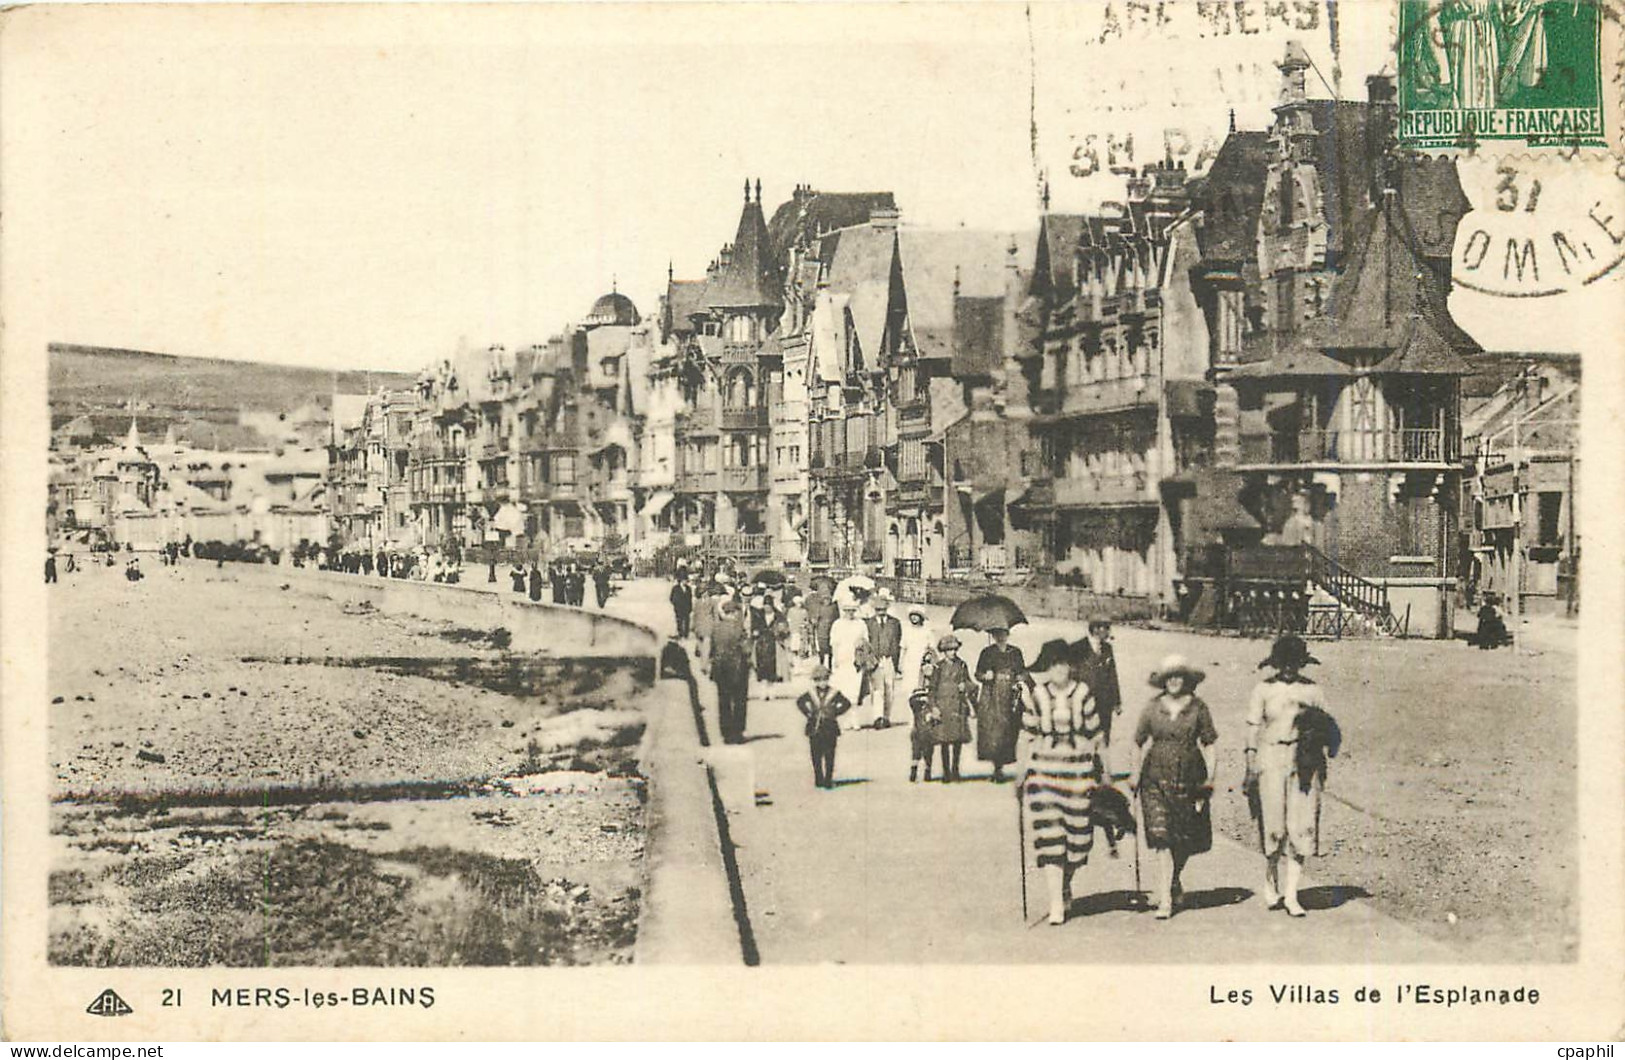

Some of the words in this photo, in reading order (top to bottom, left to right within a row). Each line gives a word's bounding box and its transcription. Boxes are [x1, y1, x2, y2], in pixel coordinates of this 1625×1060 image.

[1496, 166, 1542, 212] 31
[161, 988, 182, 1007] 21
[211, 986, 436, 1009] MERS-les-BAINS
[1210, 985, 1253, 1005] Les
[1269, 984, 1340, 1005] Villas
[1354, 985, 1382, 1004] de
[1397, 984, 1541, 1008] l'Esplanade
